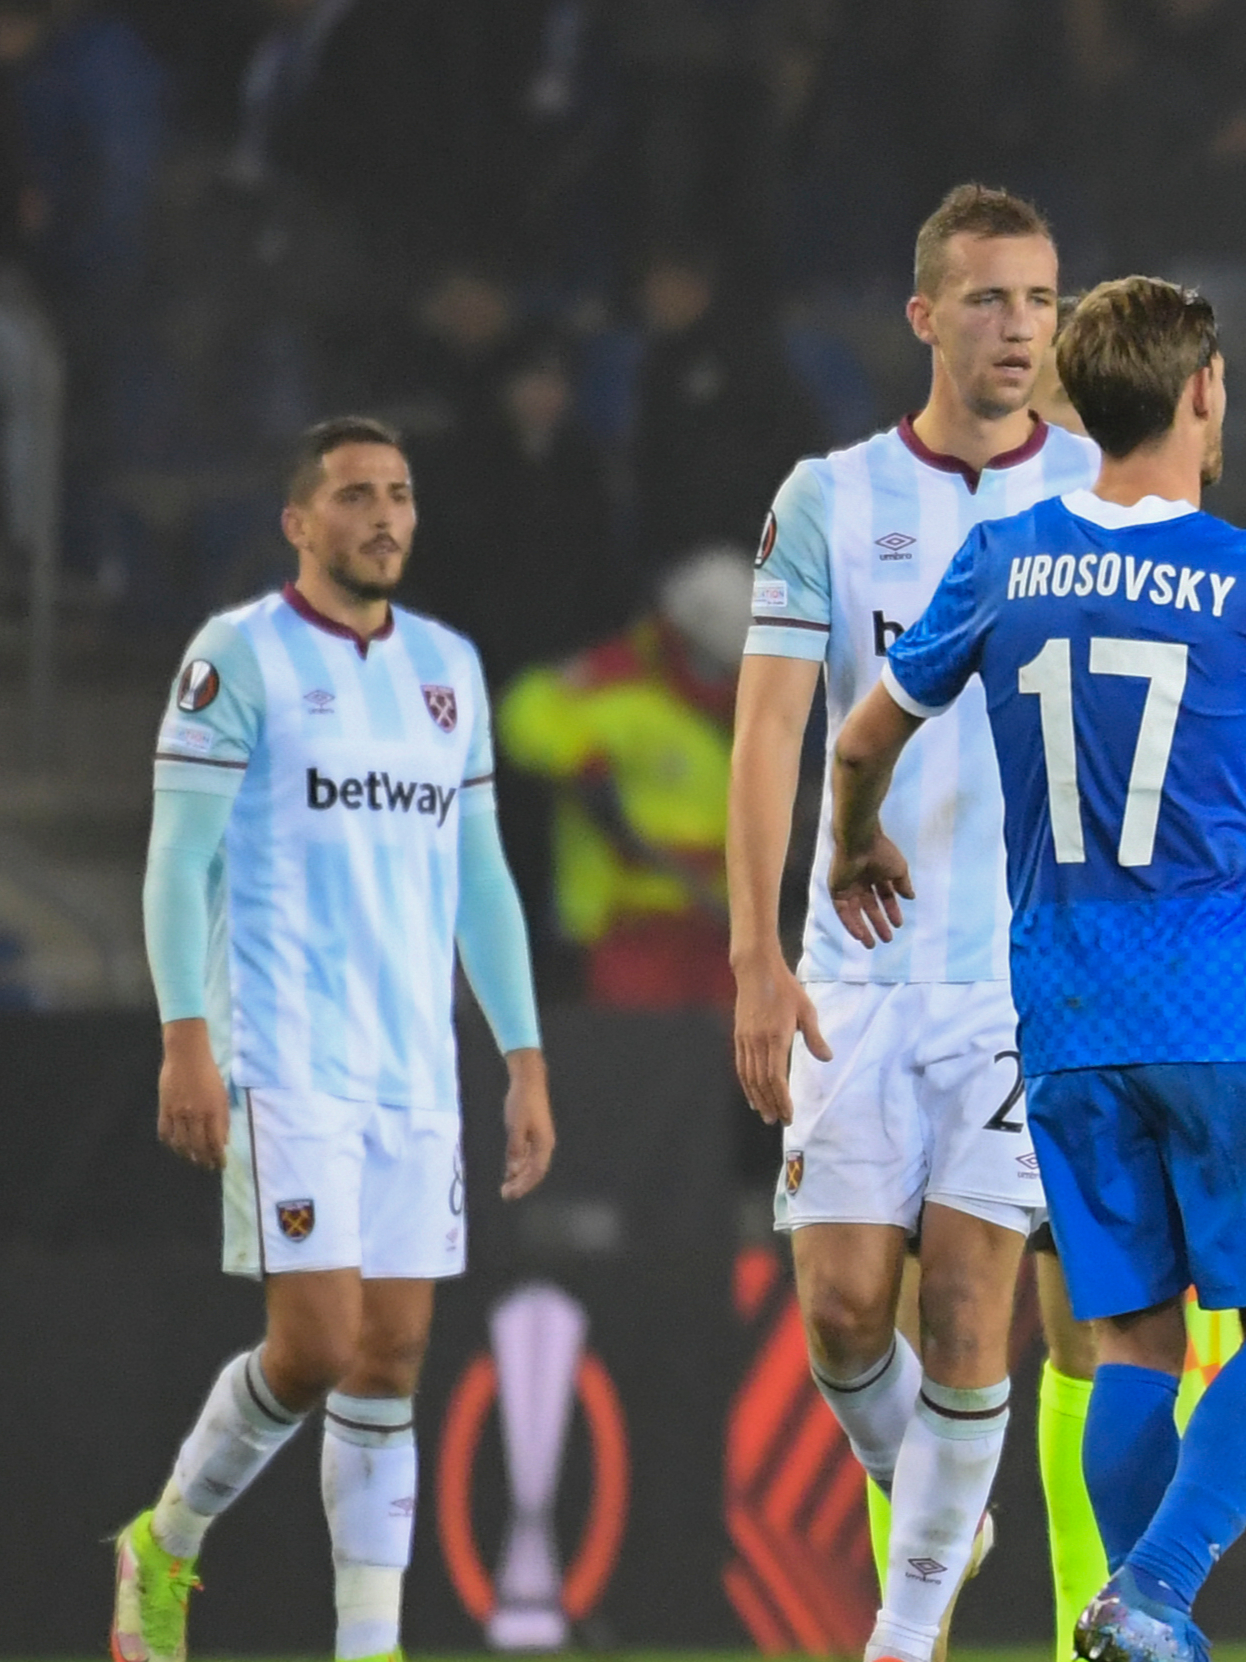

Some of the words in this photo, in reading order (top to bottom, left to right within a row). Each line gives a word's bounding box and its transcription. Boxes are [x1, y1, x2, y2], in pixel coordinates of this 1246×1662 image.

[1008, 553, 1235, 617] HROSOVSKY
[1018, 637, 1188, 867] 17
[306, 767, 457, 828] betway
